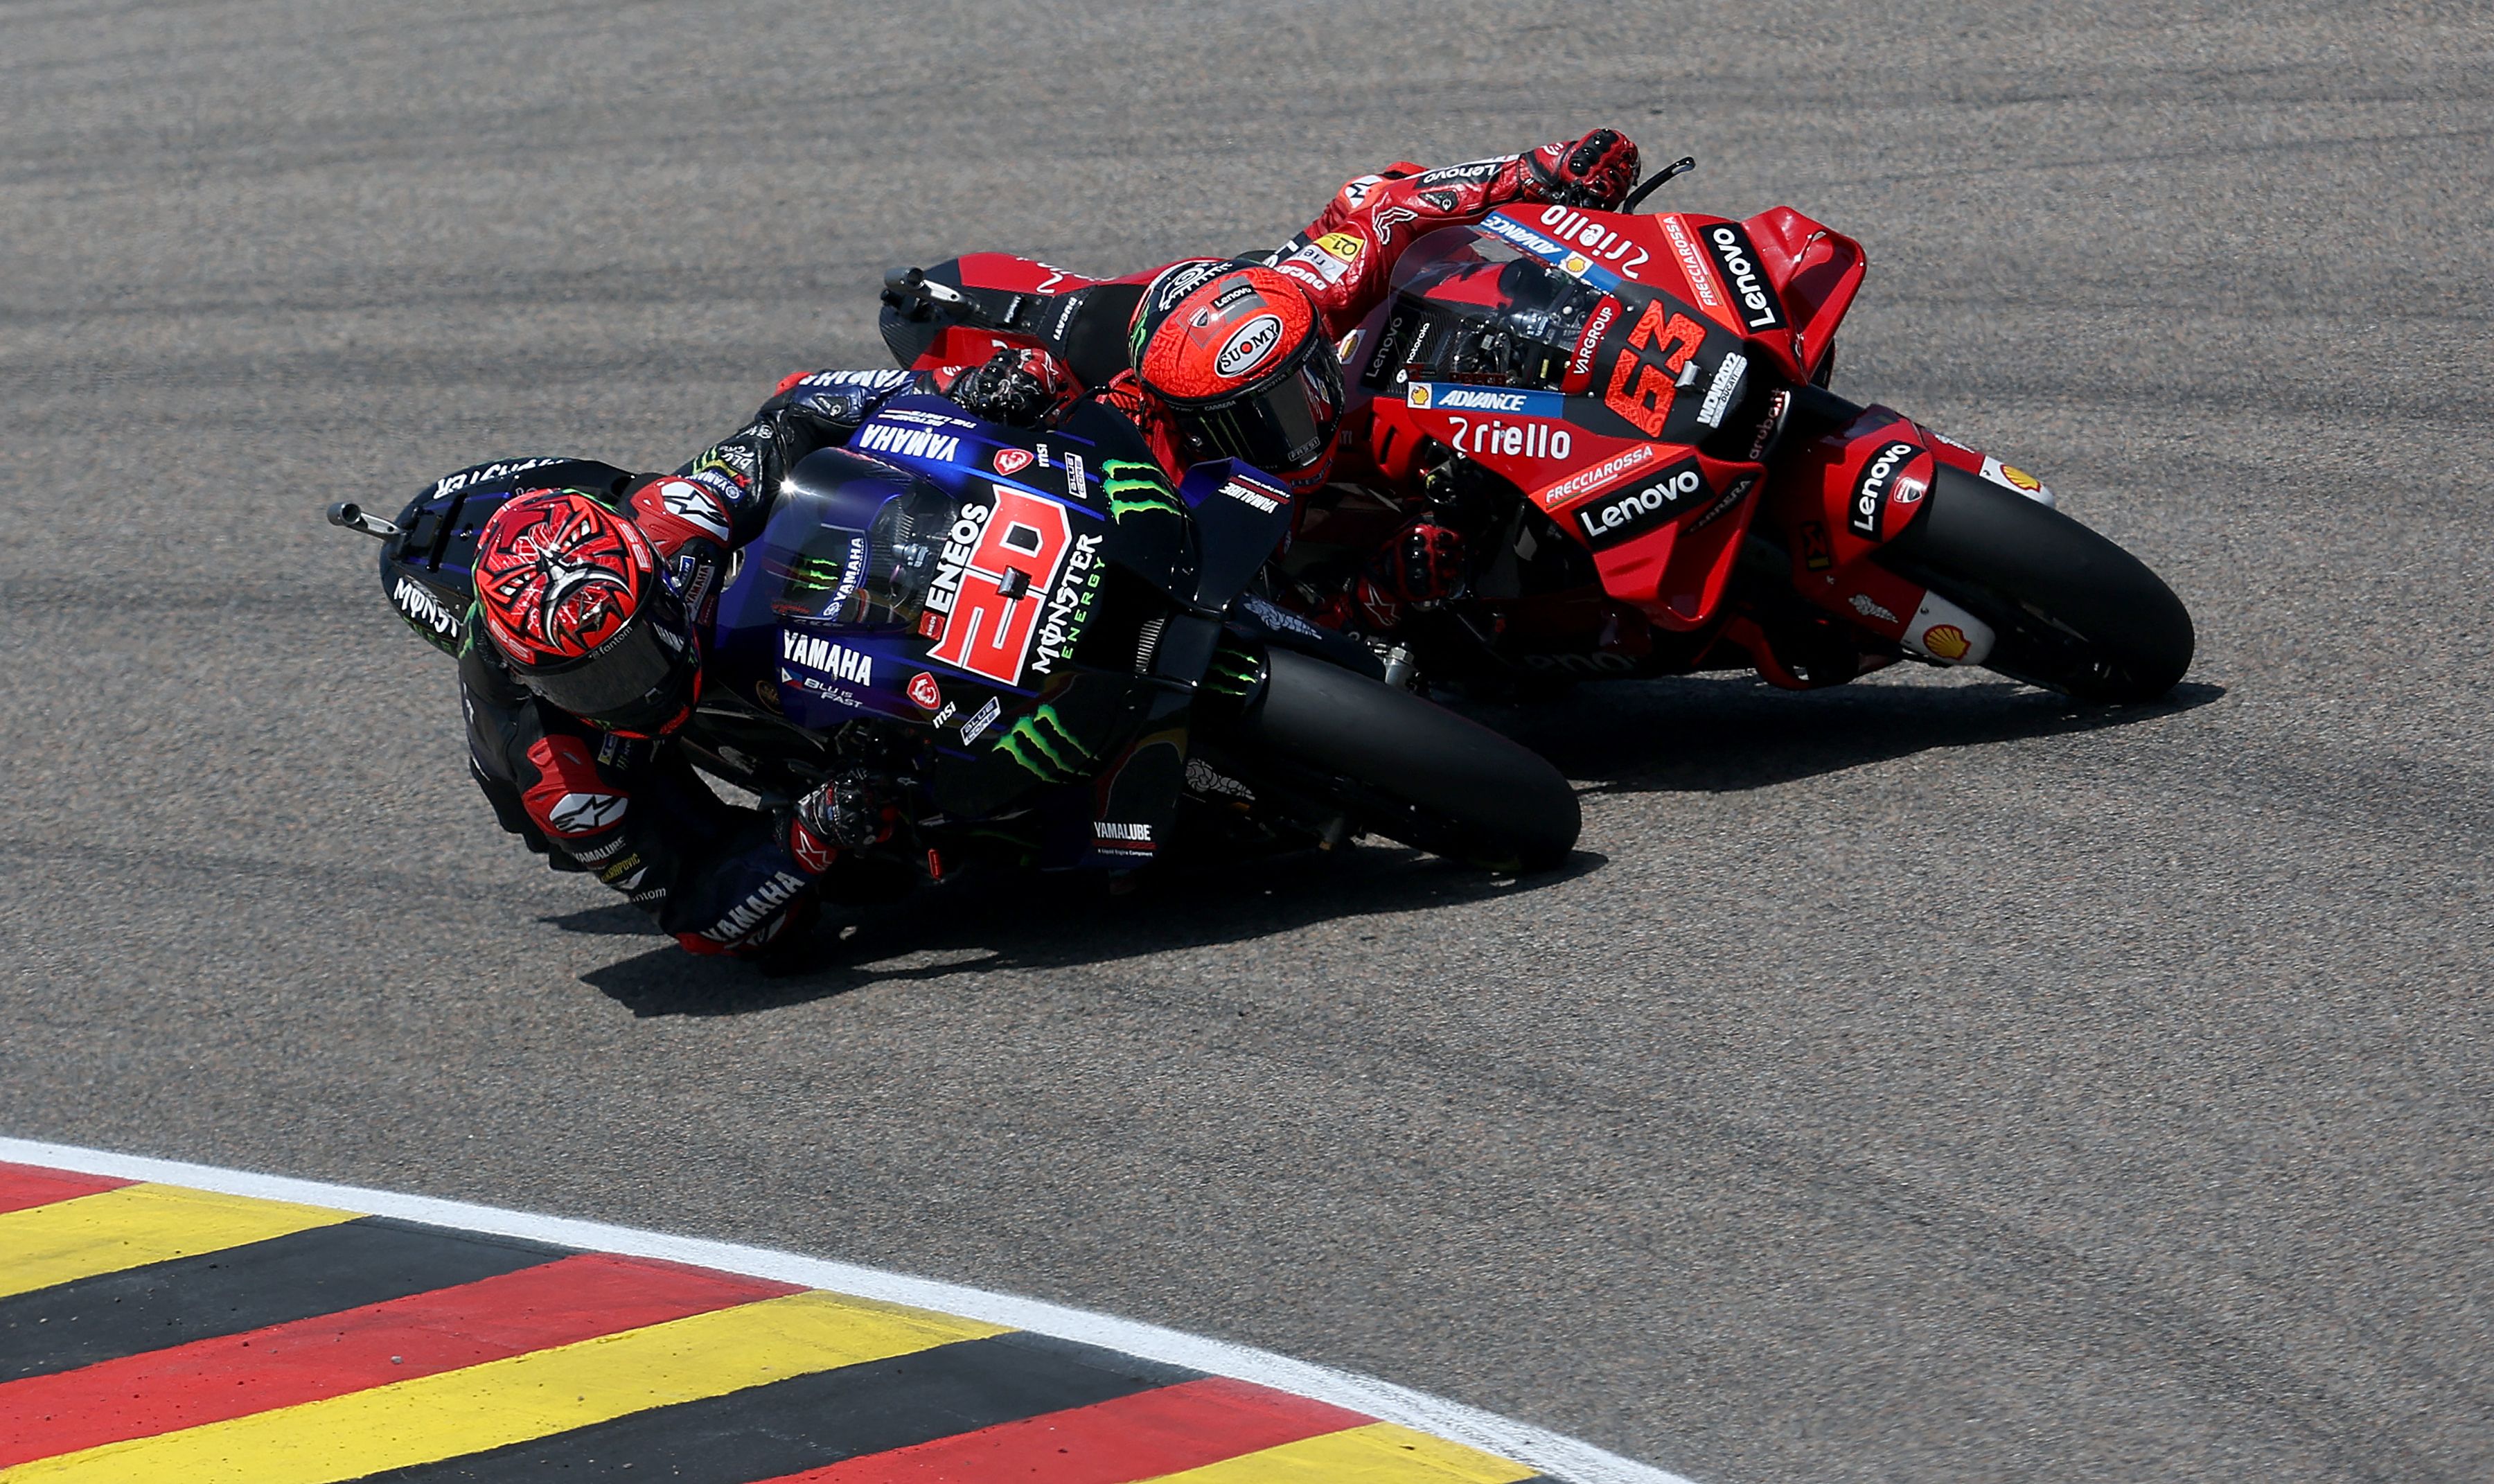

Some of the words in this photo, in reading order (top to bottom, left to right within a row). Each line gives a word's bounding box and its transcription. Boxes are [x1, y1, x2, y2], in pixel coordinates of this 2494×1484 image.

[1423, 164, 1496, 184] Lenovo
[1480, 215, 1563, 254] ADVANCE
[1662, 215, 1717, 307] FRECCIAROSSA
[1713, 228, 1777, 328] Lenovo
[1052, 297, 1077, 341] DUCATI
[1219, 324, 1279, 368] SUOMY
[1573, 306, 1613, 376] VARGROUP
[1604, 298, 1708, 439] 63
[1696, 351, 1740, 424] WDW2022
[1438, 389, 1528, 412] ADVANCE
[1749, 387, 1784, 459] aruba.it
[858, 423, 960, 462] YAMAHA
[1036, 443, 1050, 468] msi
[1218, 482, 1279, 514] YAMALUBE
[1545, 445, 1654, 504] FRECCIAROSSA
[1853, 443, 1912, 531] Lenovo
[1580, 470, 1700, 538] Lenovo
[686, 565, 709, 604] YAMAHA
[833, 536, 863, 603] YAMAHA
[925, 503, 989, 613] ENEOS
[926, 484, 1072, 687] 20
[926, 615, 937, 636] ENEOS
[1032, 533, 1104, 675] MONSTER
[1061, 556, 1106, 660] ENERGY
[599, 625, 633, 655] fantom
[784, 629, 873, 687] YAMAHA
[932, 700, 957, 730] msi
[572, 836, 626, 865] YAMALUBE
[1093, 821, 1152, 841] YAMALUBE
[700, 870, 806, 942] YAMAHA
